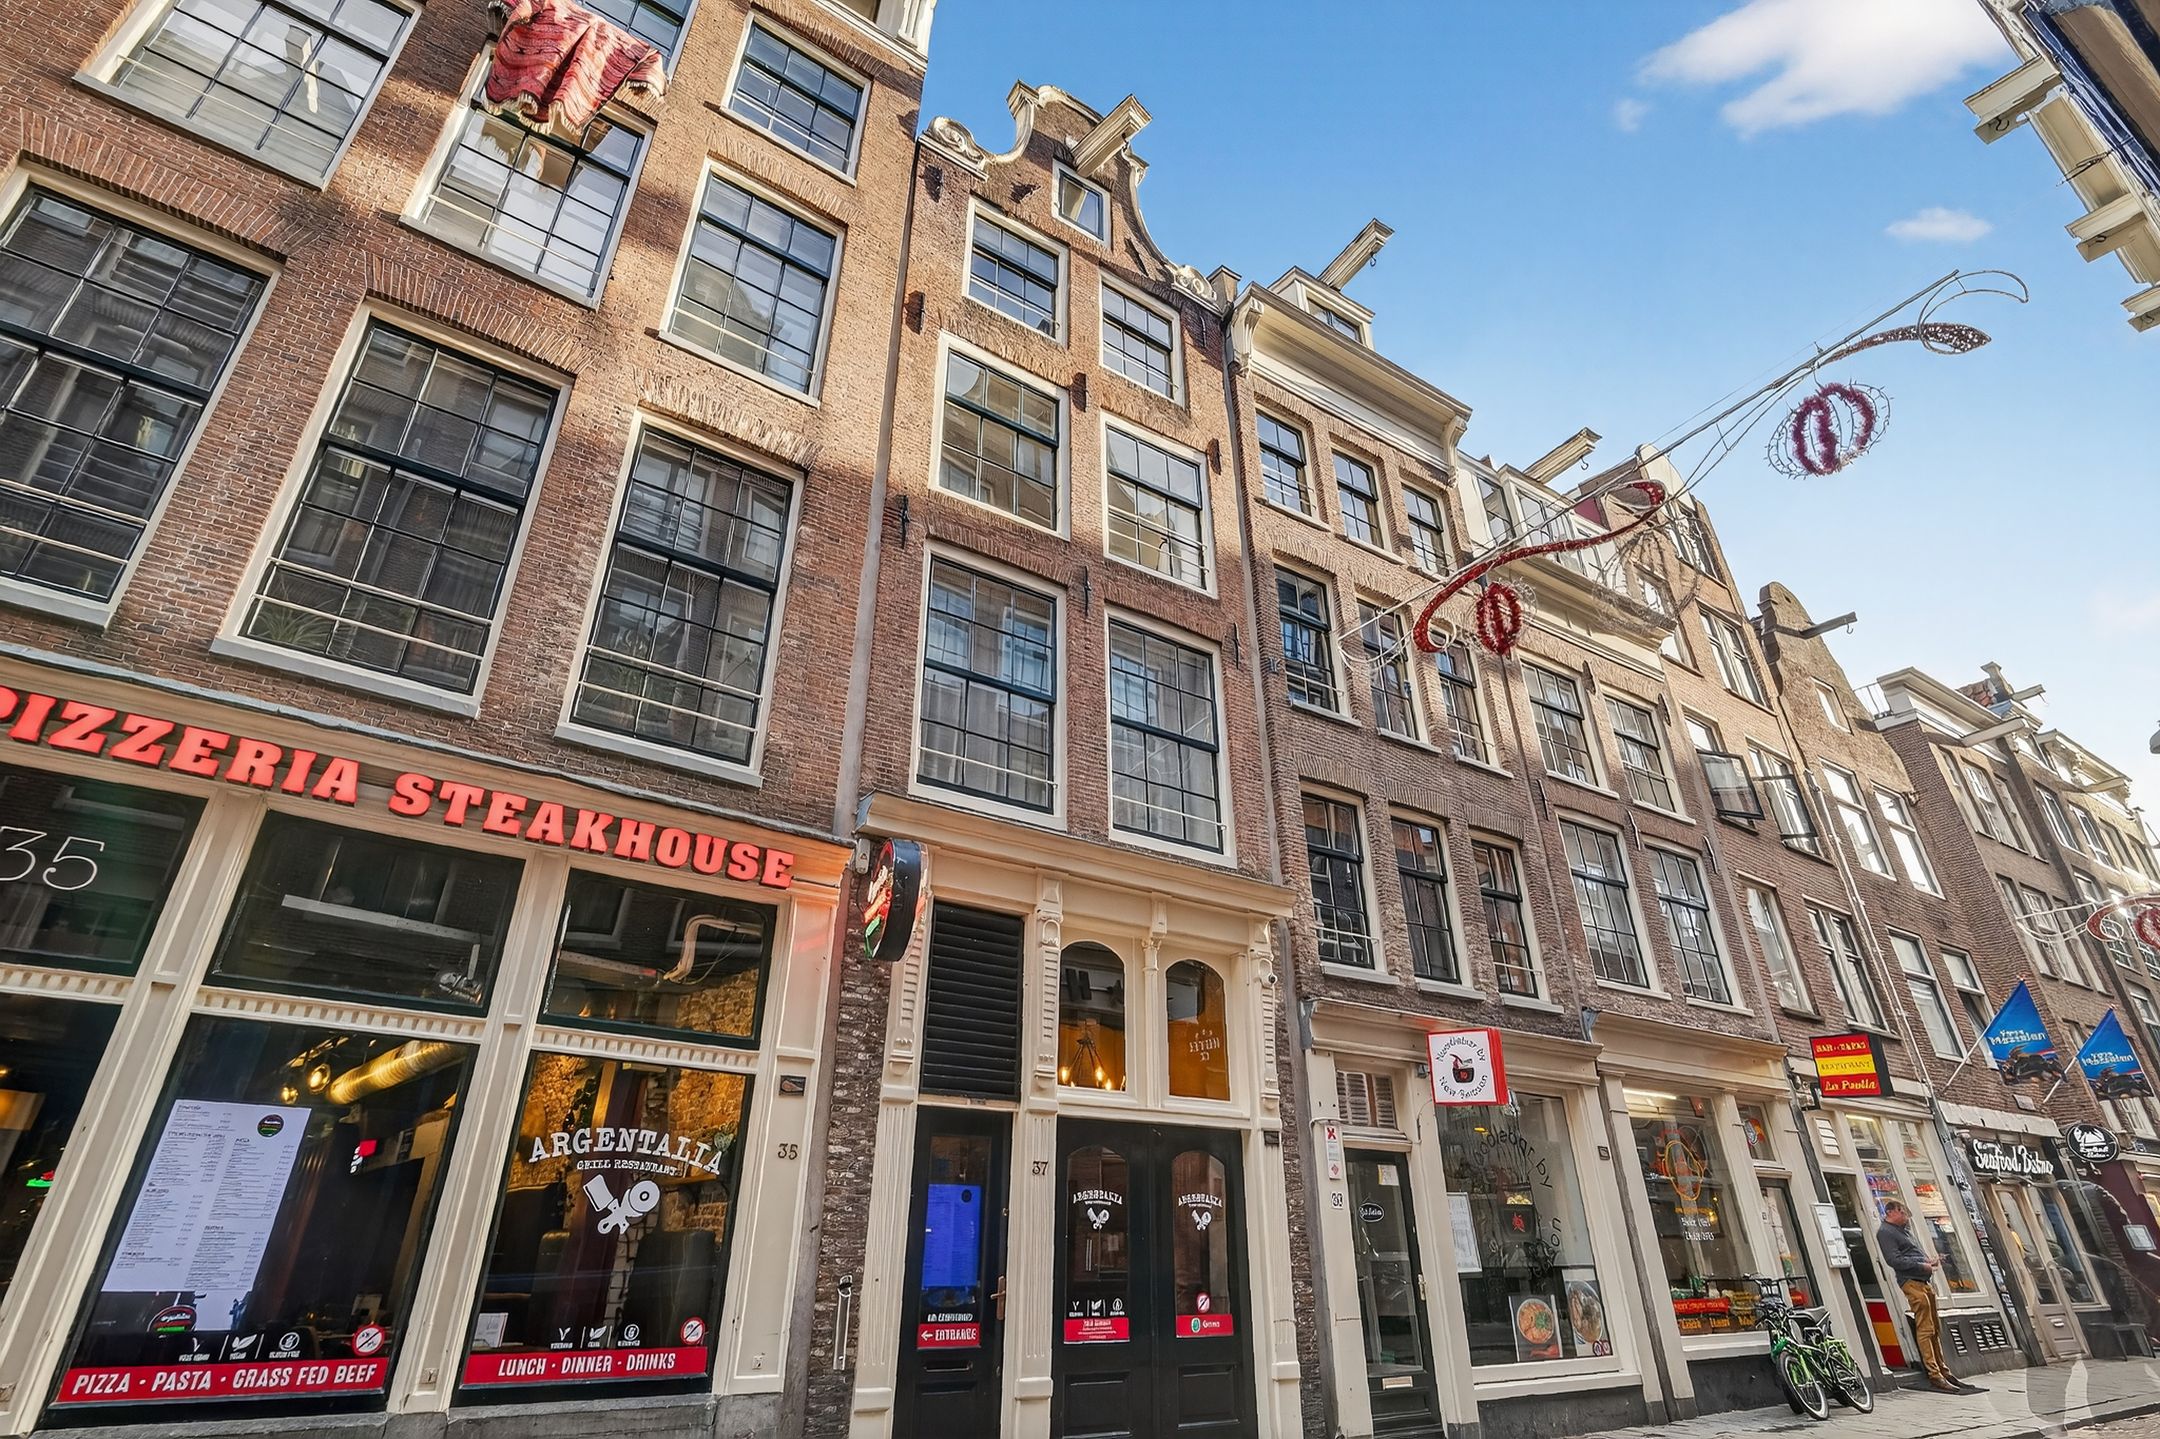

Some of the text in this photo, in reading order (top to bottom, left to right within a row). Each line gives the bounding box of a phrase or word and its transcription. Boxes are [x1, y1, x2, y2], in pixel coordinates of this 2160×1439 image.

[387, 771, 796, 890] STEAKHOUSE
[0, 825, 105, 891] 35
[528, 1127, 724, 1176] ARGENTALIA
[777, 1142, 799, 1161] 35
[1032, 1160, 1049, 1177] 37
[72, 1363, 378, 1395] PIZZA PASTA GRASS FED BEEF
[498, 1352, 676, 1377] LUNCH DINNER DRINKS
